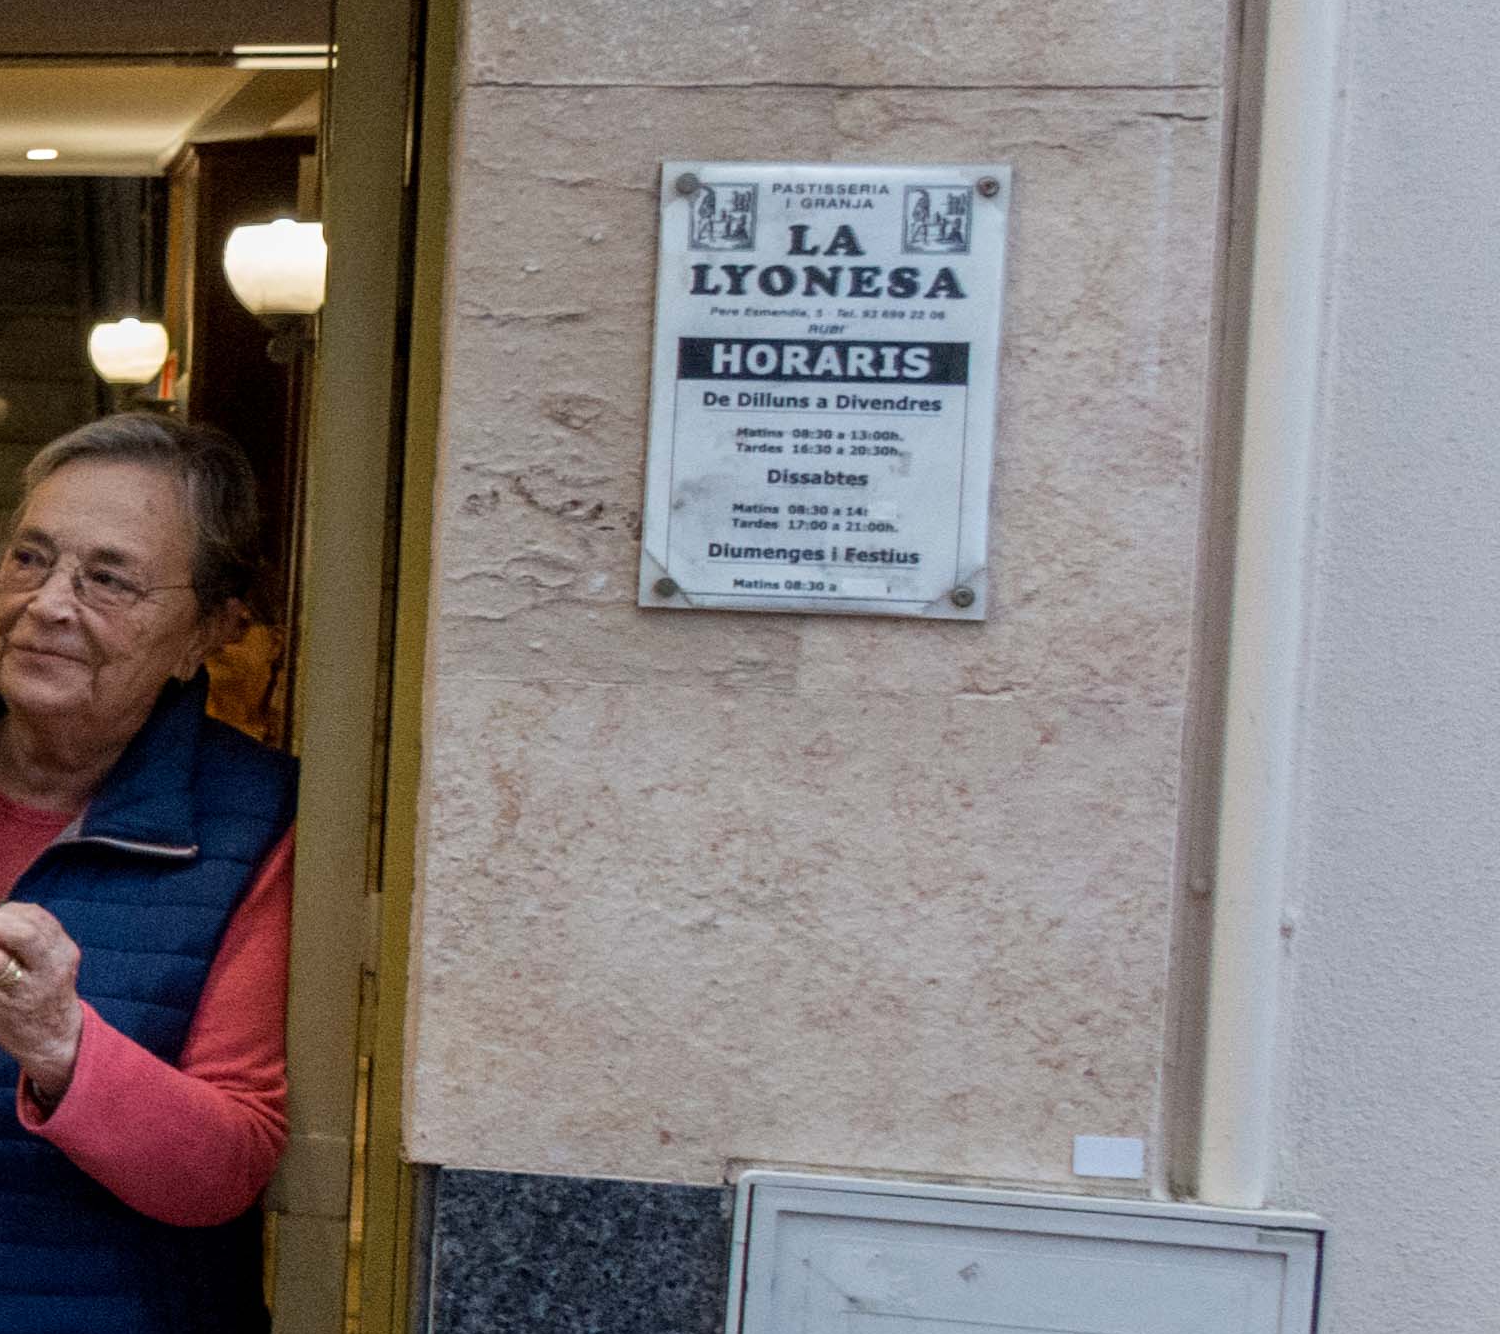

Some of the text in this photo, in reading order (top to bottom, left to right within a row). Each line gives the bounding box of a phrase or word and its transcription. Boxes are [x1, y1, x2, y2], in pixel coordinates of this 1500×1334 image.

[772, 183, 889, 195] PASTISSERIA
[801, 198, 874, 209] GRANJA
[787, 224, 866, 256] LA
[690, 264, 966, 298] LYONESA
[712, 343, 931, 378] HORARIS
[703, 392, 942, 412] De Dilluns a Divendres
[737, 428, 783, 438] Matins
[793, 429, 832, 439] 08:30
[836, 432, 845, 440] a
[737, 443, 783, 454] Tardes
[836, 447, 844, 455] a
[767, 469, 869, 486] Dissabtes
[733, 504, 779, 515] Matins
[788, 505, 828, 516] 08:30
[833, 508, 841, 516] a
[732, 518, 778, 529] Tardes
[788, 520, 828, 531] 17:00
[832, 523, 840, 531] a
[708, 543, 920, 564] Diumenges i Festius
[733, 579, 837, 592] Matins 08:30 a
